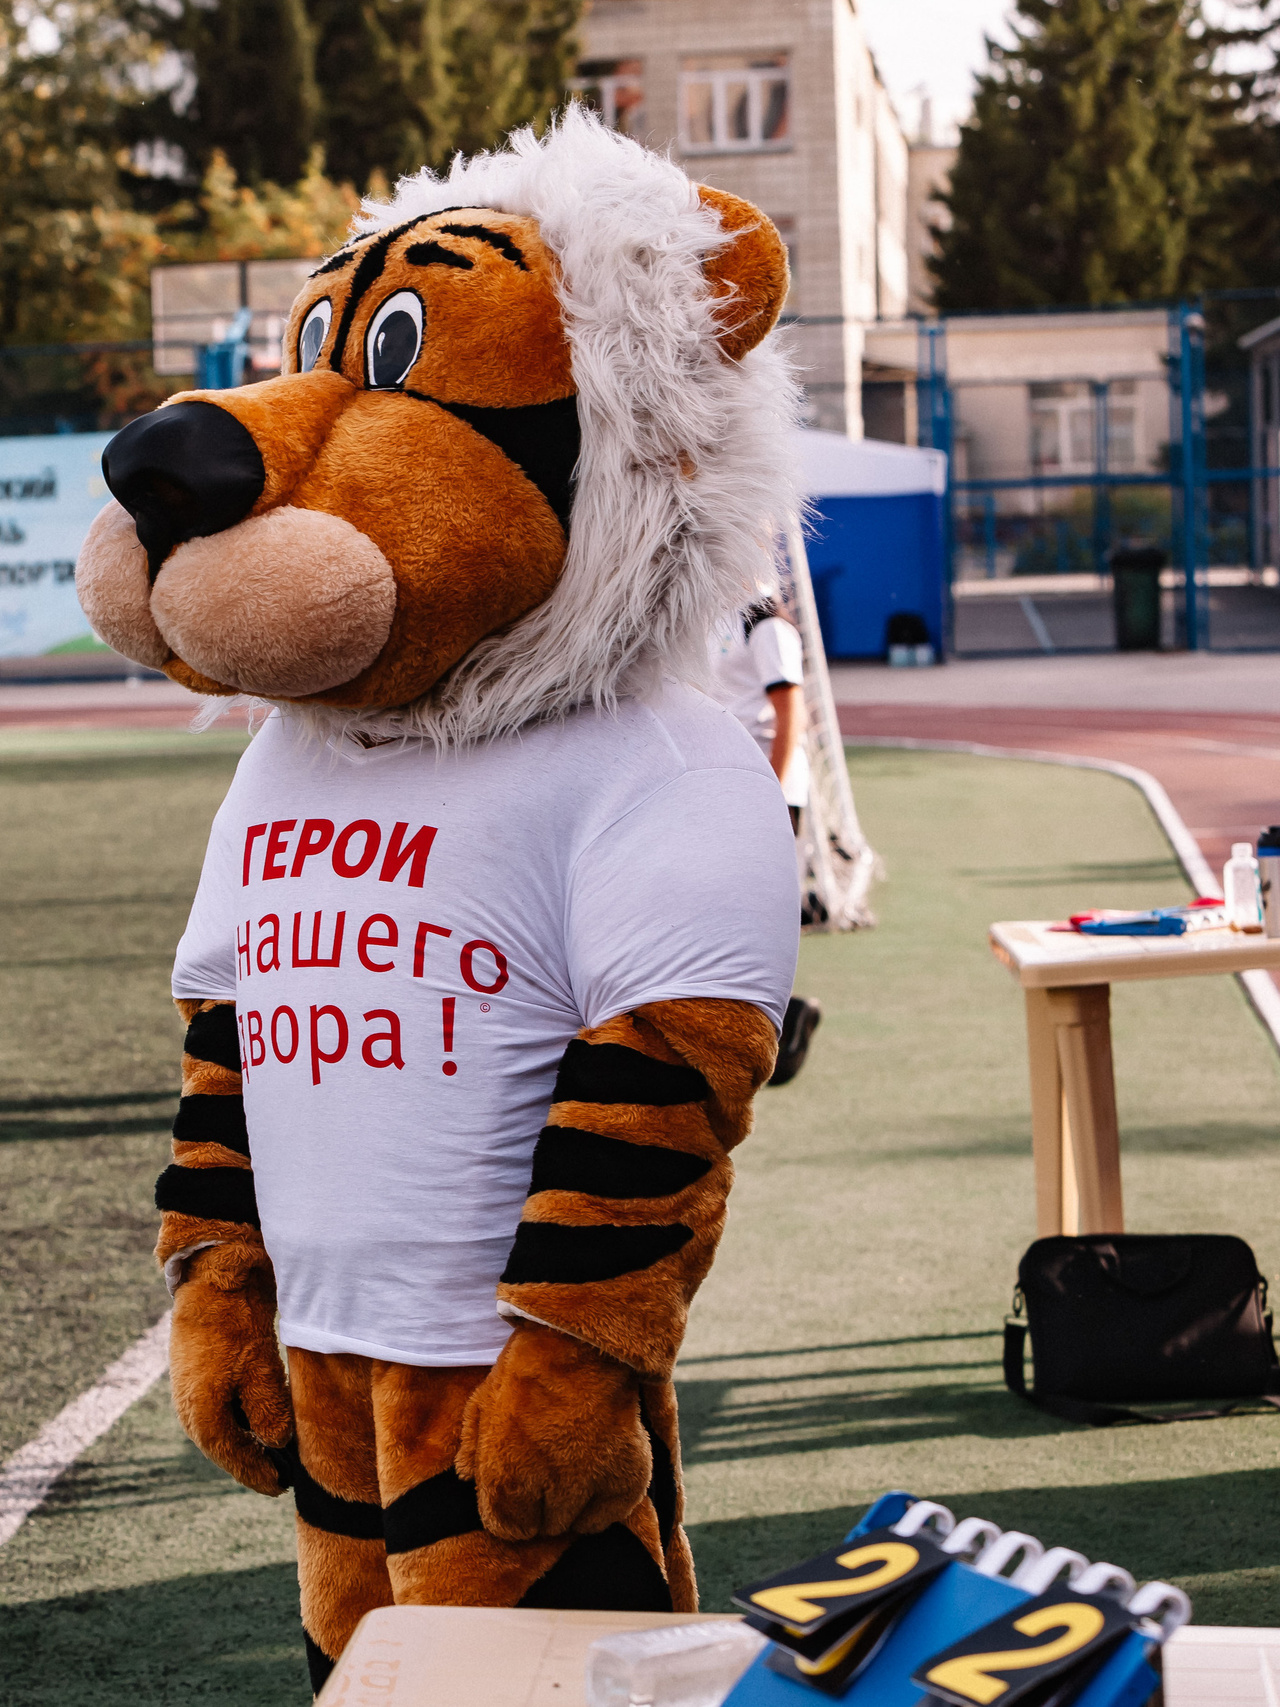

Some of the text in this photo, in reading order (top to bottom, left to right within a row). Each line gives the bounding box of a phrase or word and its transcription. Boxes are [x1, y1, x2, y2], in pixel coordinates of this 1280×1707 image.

[242, 818, 439, 888] ГЕРОИ
[237, 909, 509, 994] нашего
[750, 1541, 920, 1624] 2
[926, 1602, 1105, 1705] 2
